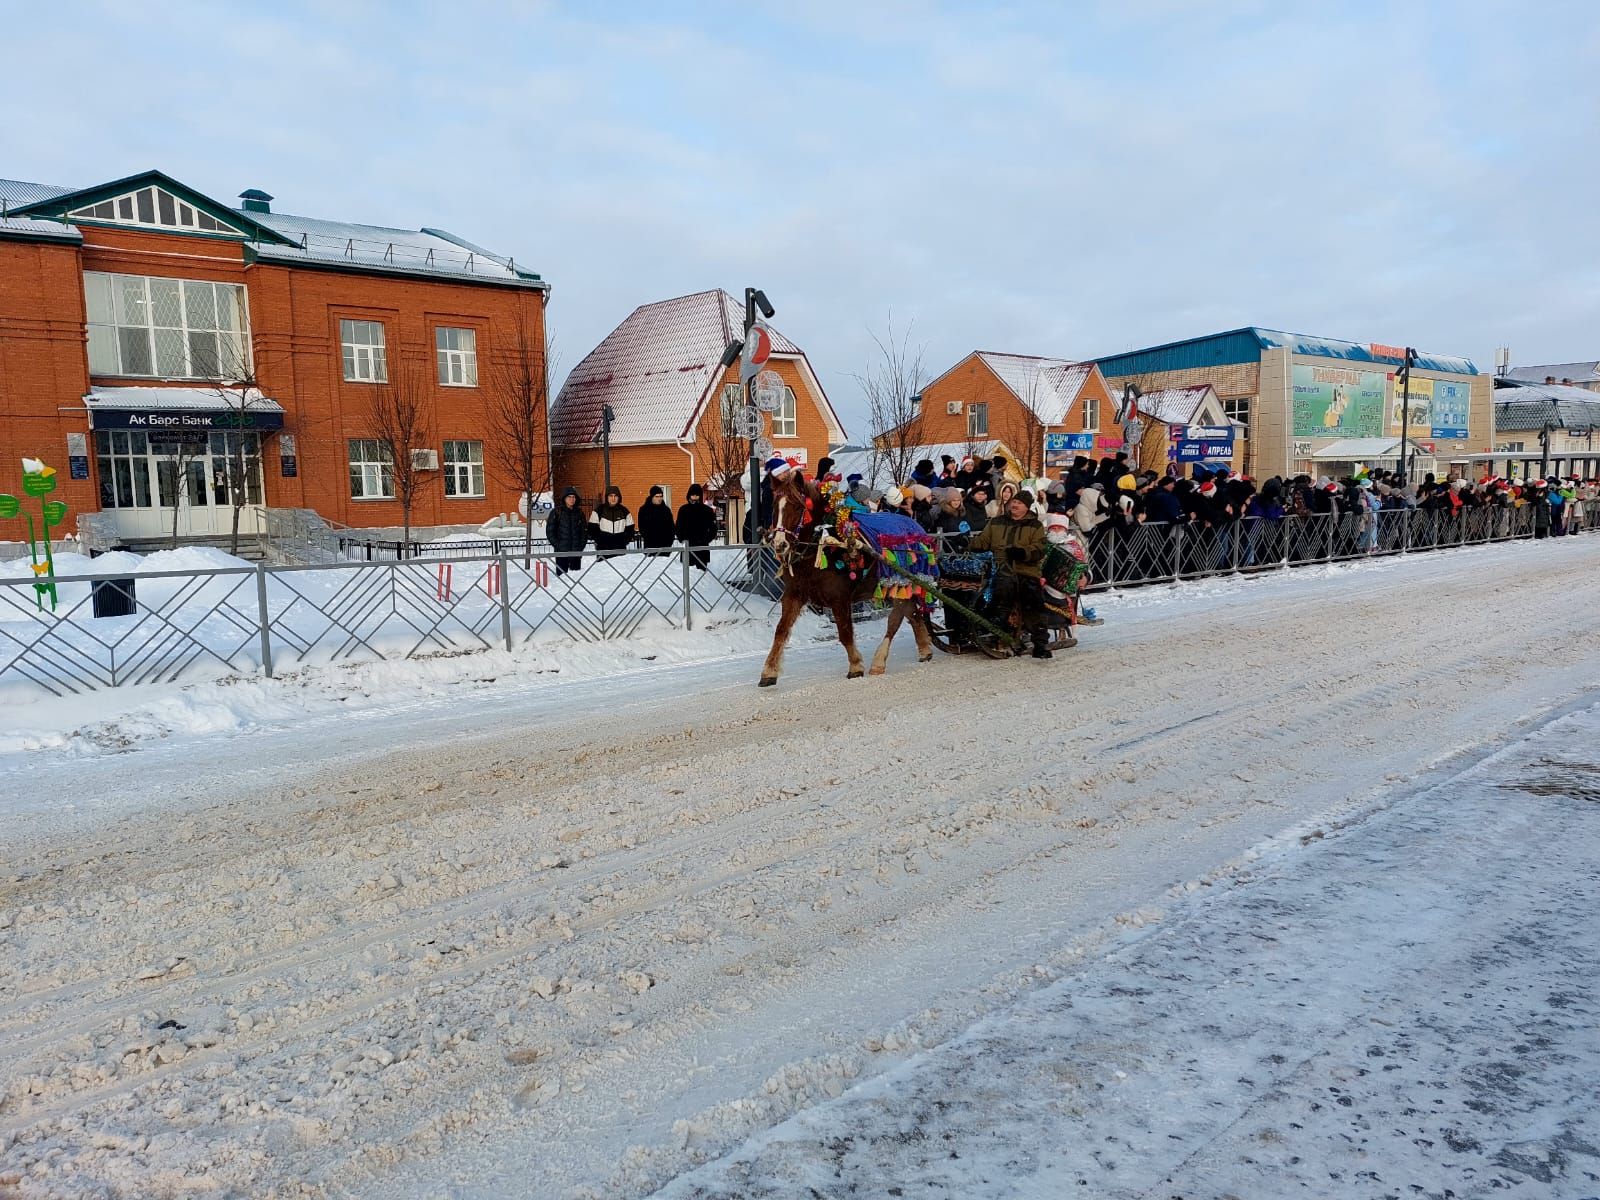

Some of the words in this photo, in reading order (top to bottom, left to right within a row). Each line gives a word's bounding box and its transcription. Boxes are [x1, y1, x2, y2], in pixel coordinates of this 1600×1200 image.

[129, 415, 146, 425] Ак
[149, 415, 179, 426] Барс
[182, 416, 213, 426] Банк
[1207, 446, 1232, 456] АПРЕЛЬ
